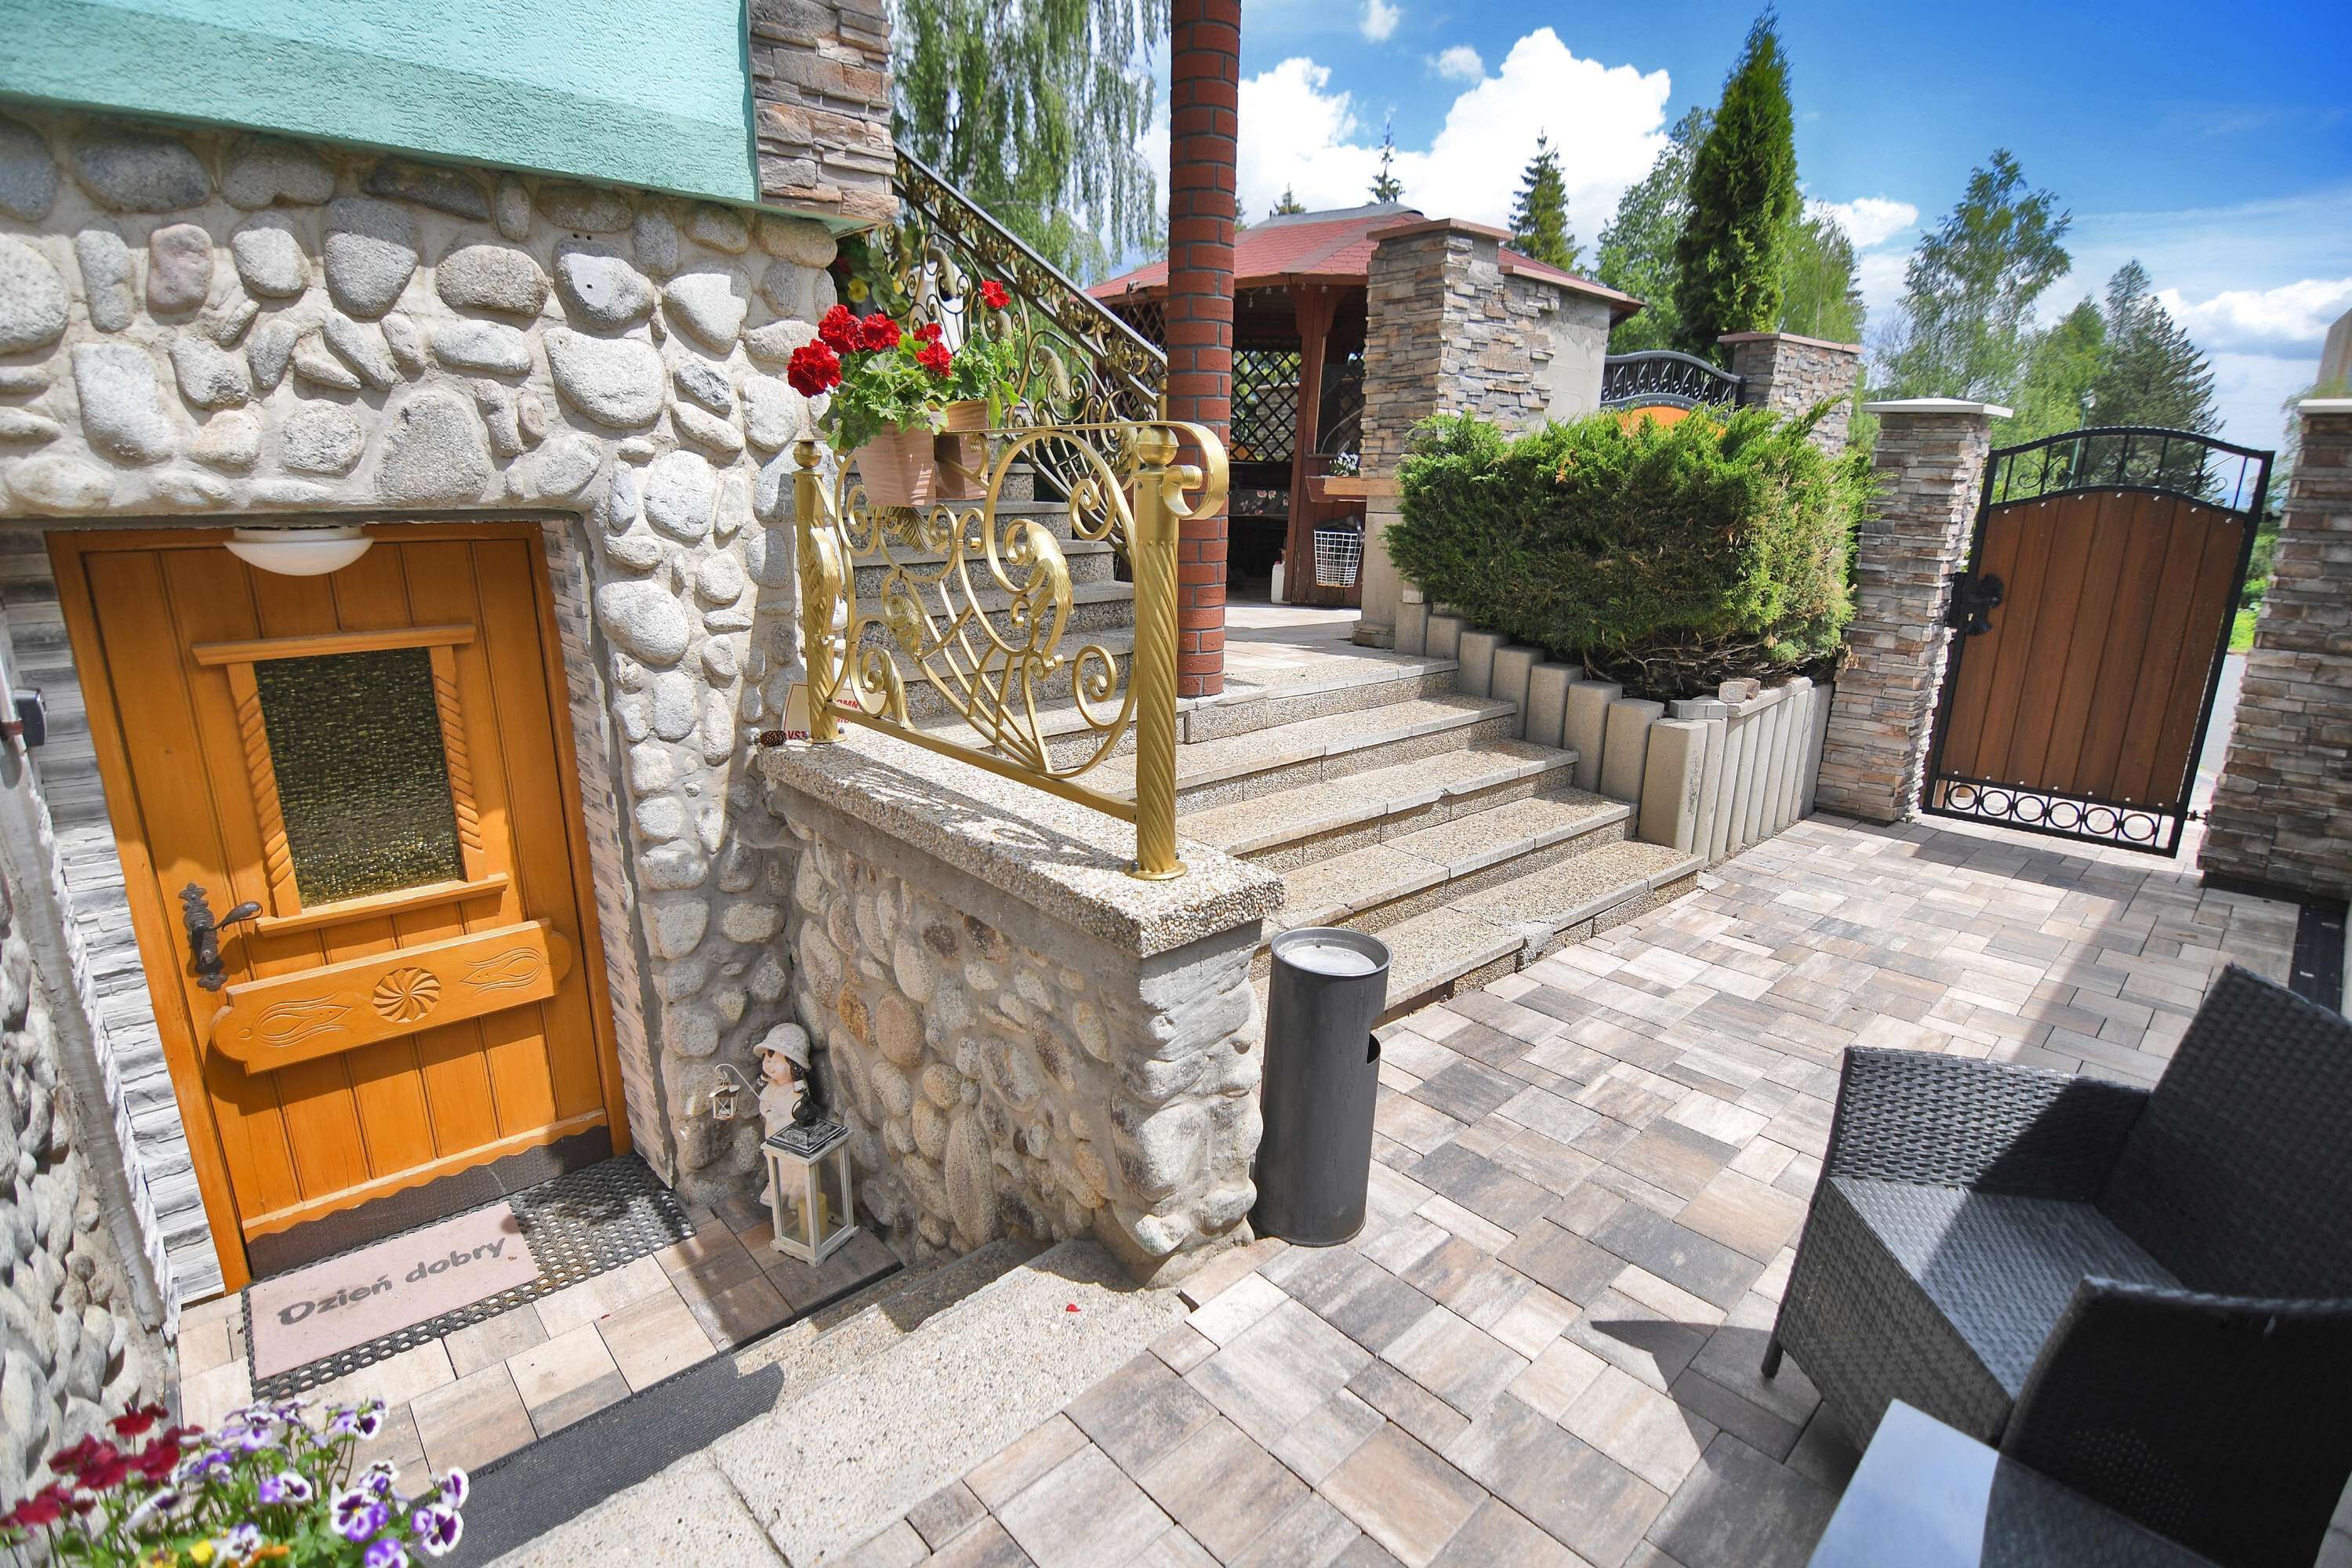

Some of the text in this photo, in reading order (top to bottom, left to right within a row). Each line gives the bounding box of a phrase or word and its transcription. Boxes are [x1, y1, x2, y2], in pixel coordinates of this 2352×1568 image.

[787, 730, 809, 739] VST
[278, 1236, 506, 1325] Dzień dobry
